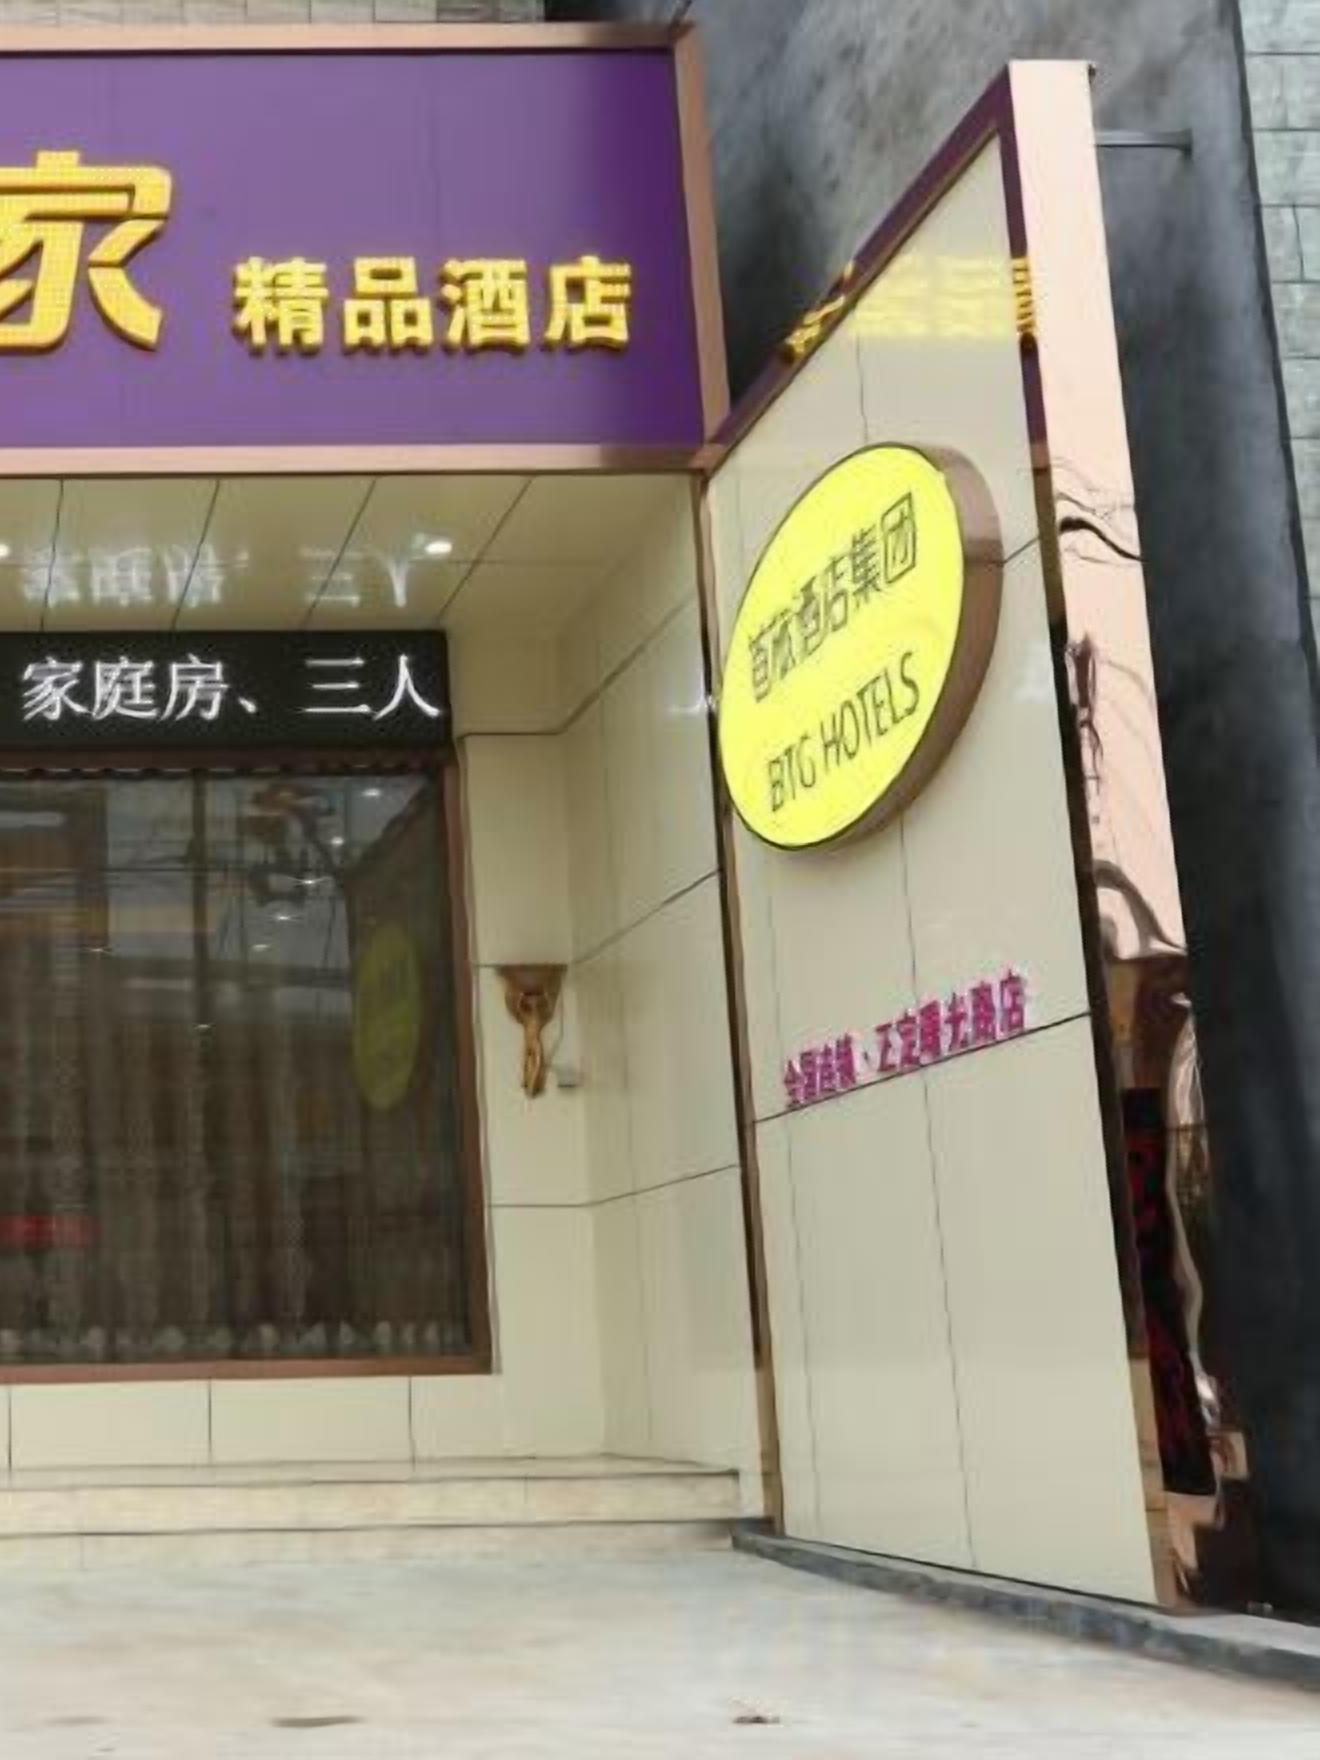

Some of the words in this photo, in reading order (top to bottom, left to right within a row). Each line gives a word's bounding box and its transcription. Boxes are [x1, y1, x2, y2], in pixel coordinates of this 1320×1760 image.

[232, 254, 633, 356] 精品酒店
[819, 650, 920, 768] HOTELS
